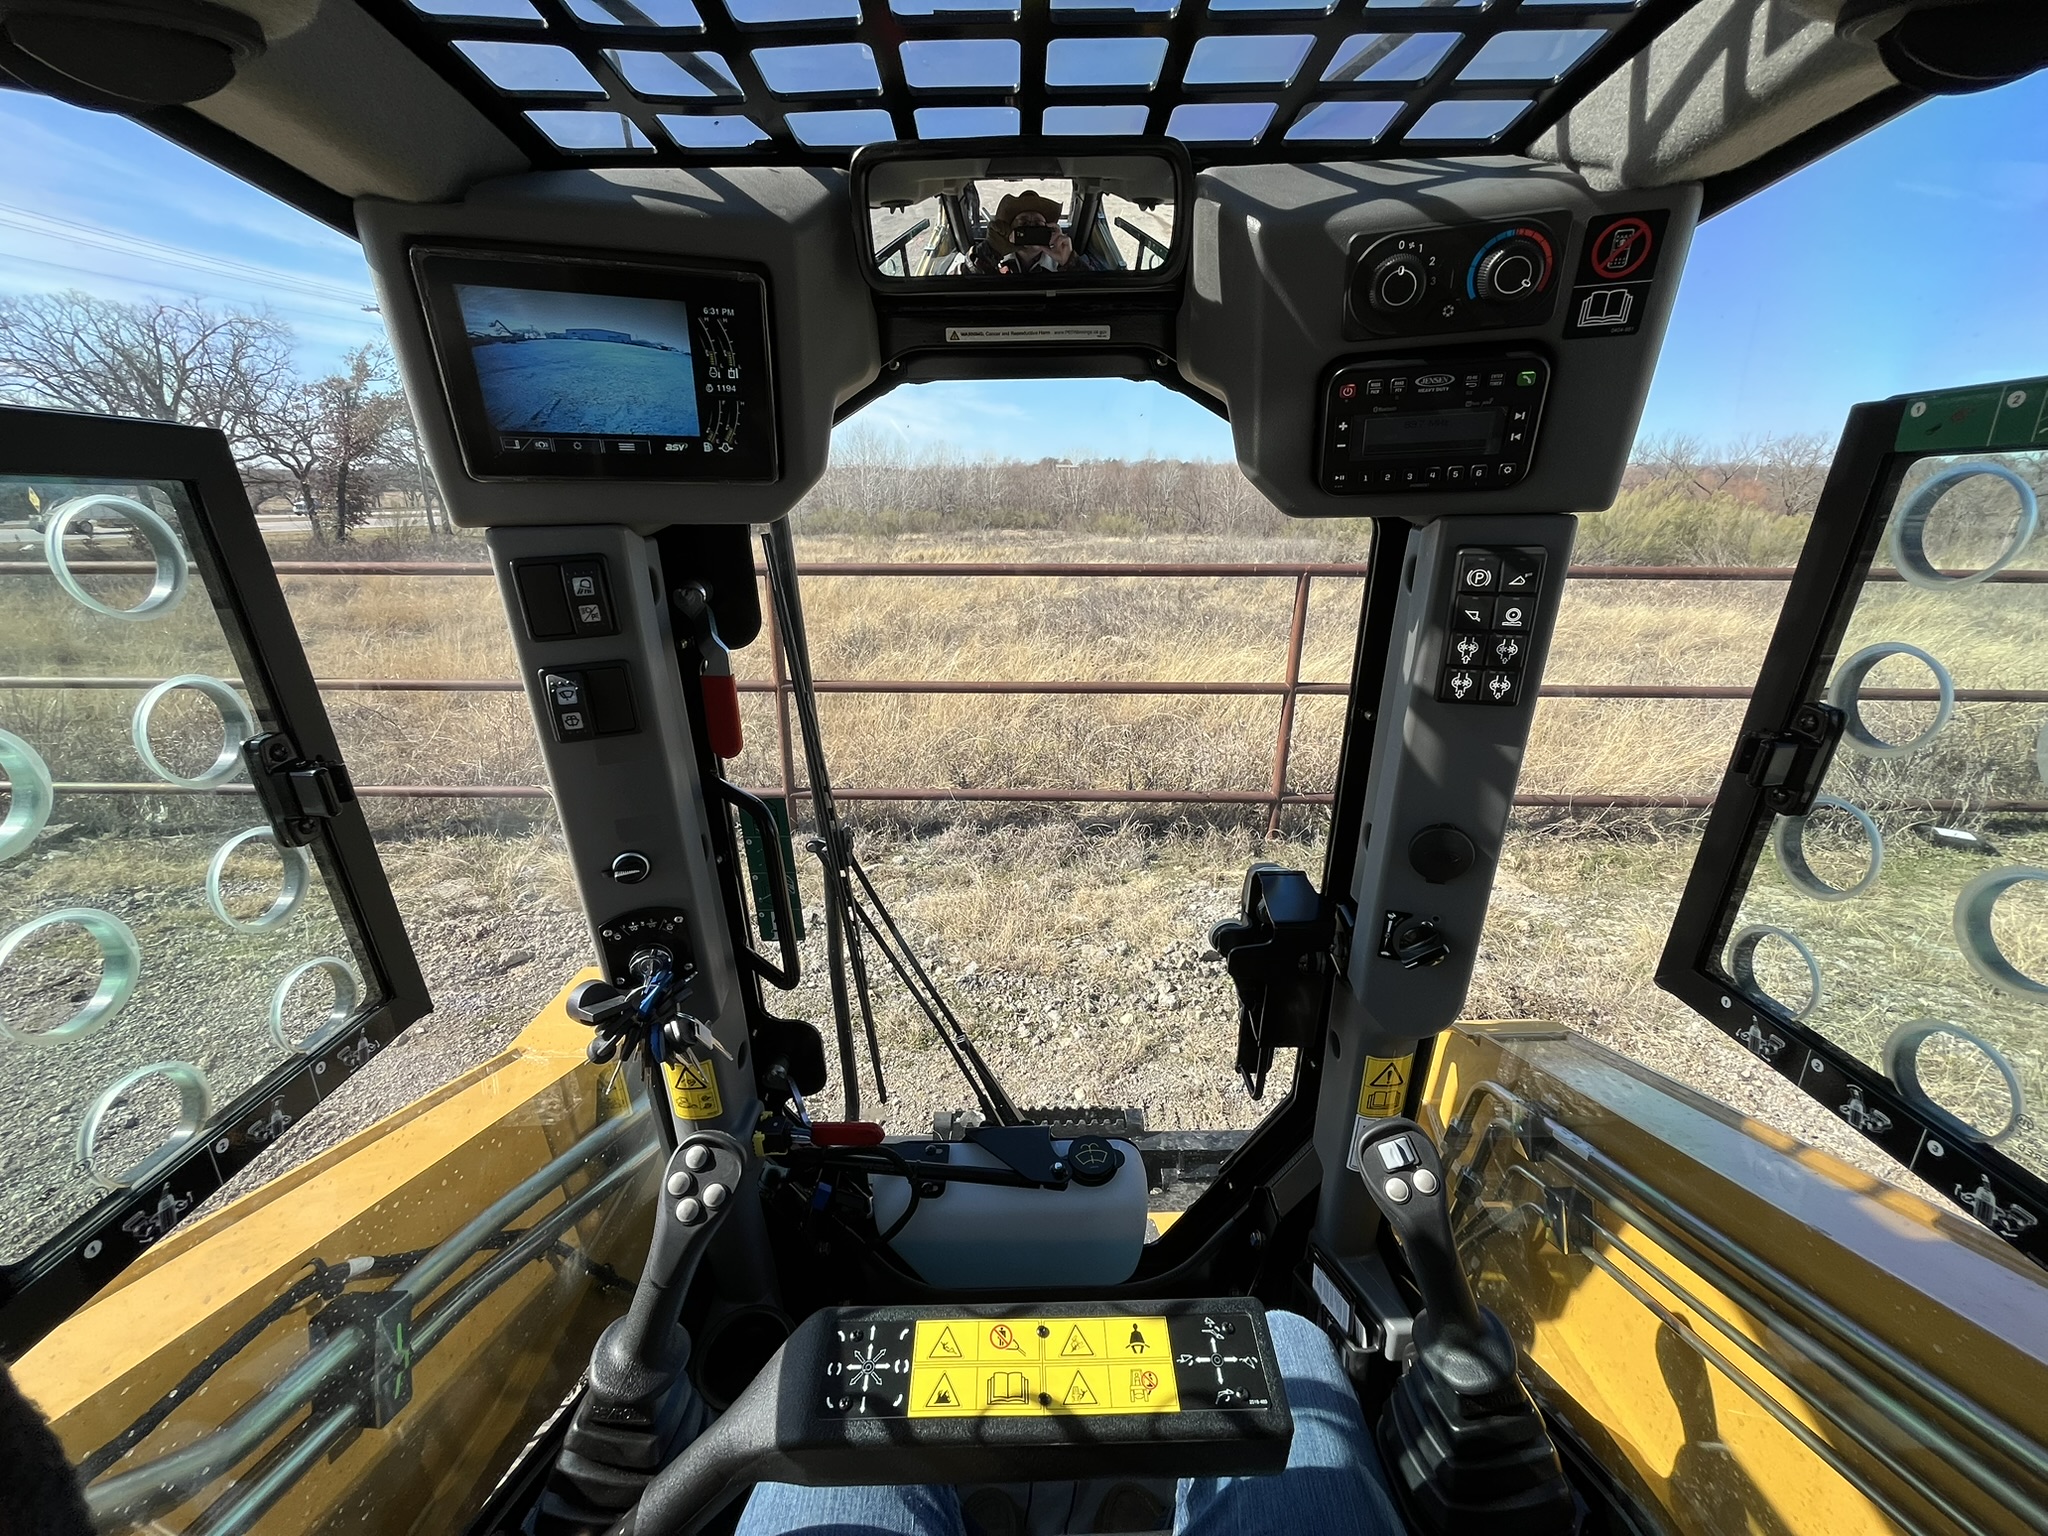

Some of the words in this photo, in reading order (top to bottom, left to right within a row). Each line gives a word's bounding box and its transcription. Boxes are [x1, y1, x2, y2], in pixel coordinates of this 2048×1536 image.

[1398, 240, 1405, 250] 0
[1418, 243, 1423, 253] 1
[1428, 256, 1436, 266] 2
[1429, 276, 1437, 286] 3
[703, 307, 719, 315] 6:31
[721, 308, 735, 316] PM
[1420, 376, 1449, 385] JENSEN
[716, 384, 737, 393] 1194
[1384, 473, 1391, 481] 2
[1429, 471, 1436, 479] 4
[1452, 470, 1459, 478] 5
[1475, 469, 1482, 477] 6
[1363, 474, 1368, 482] 1
